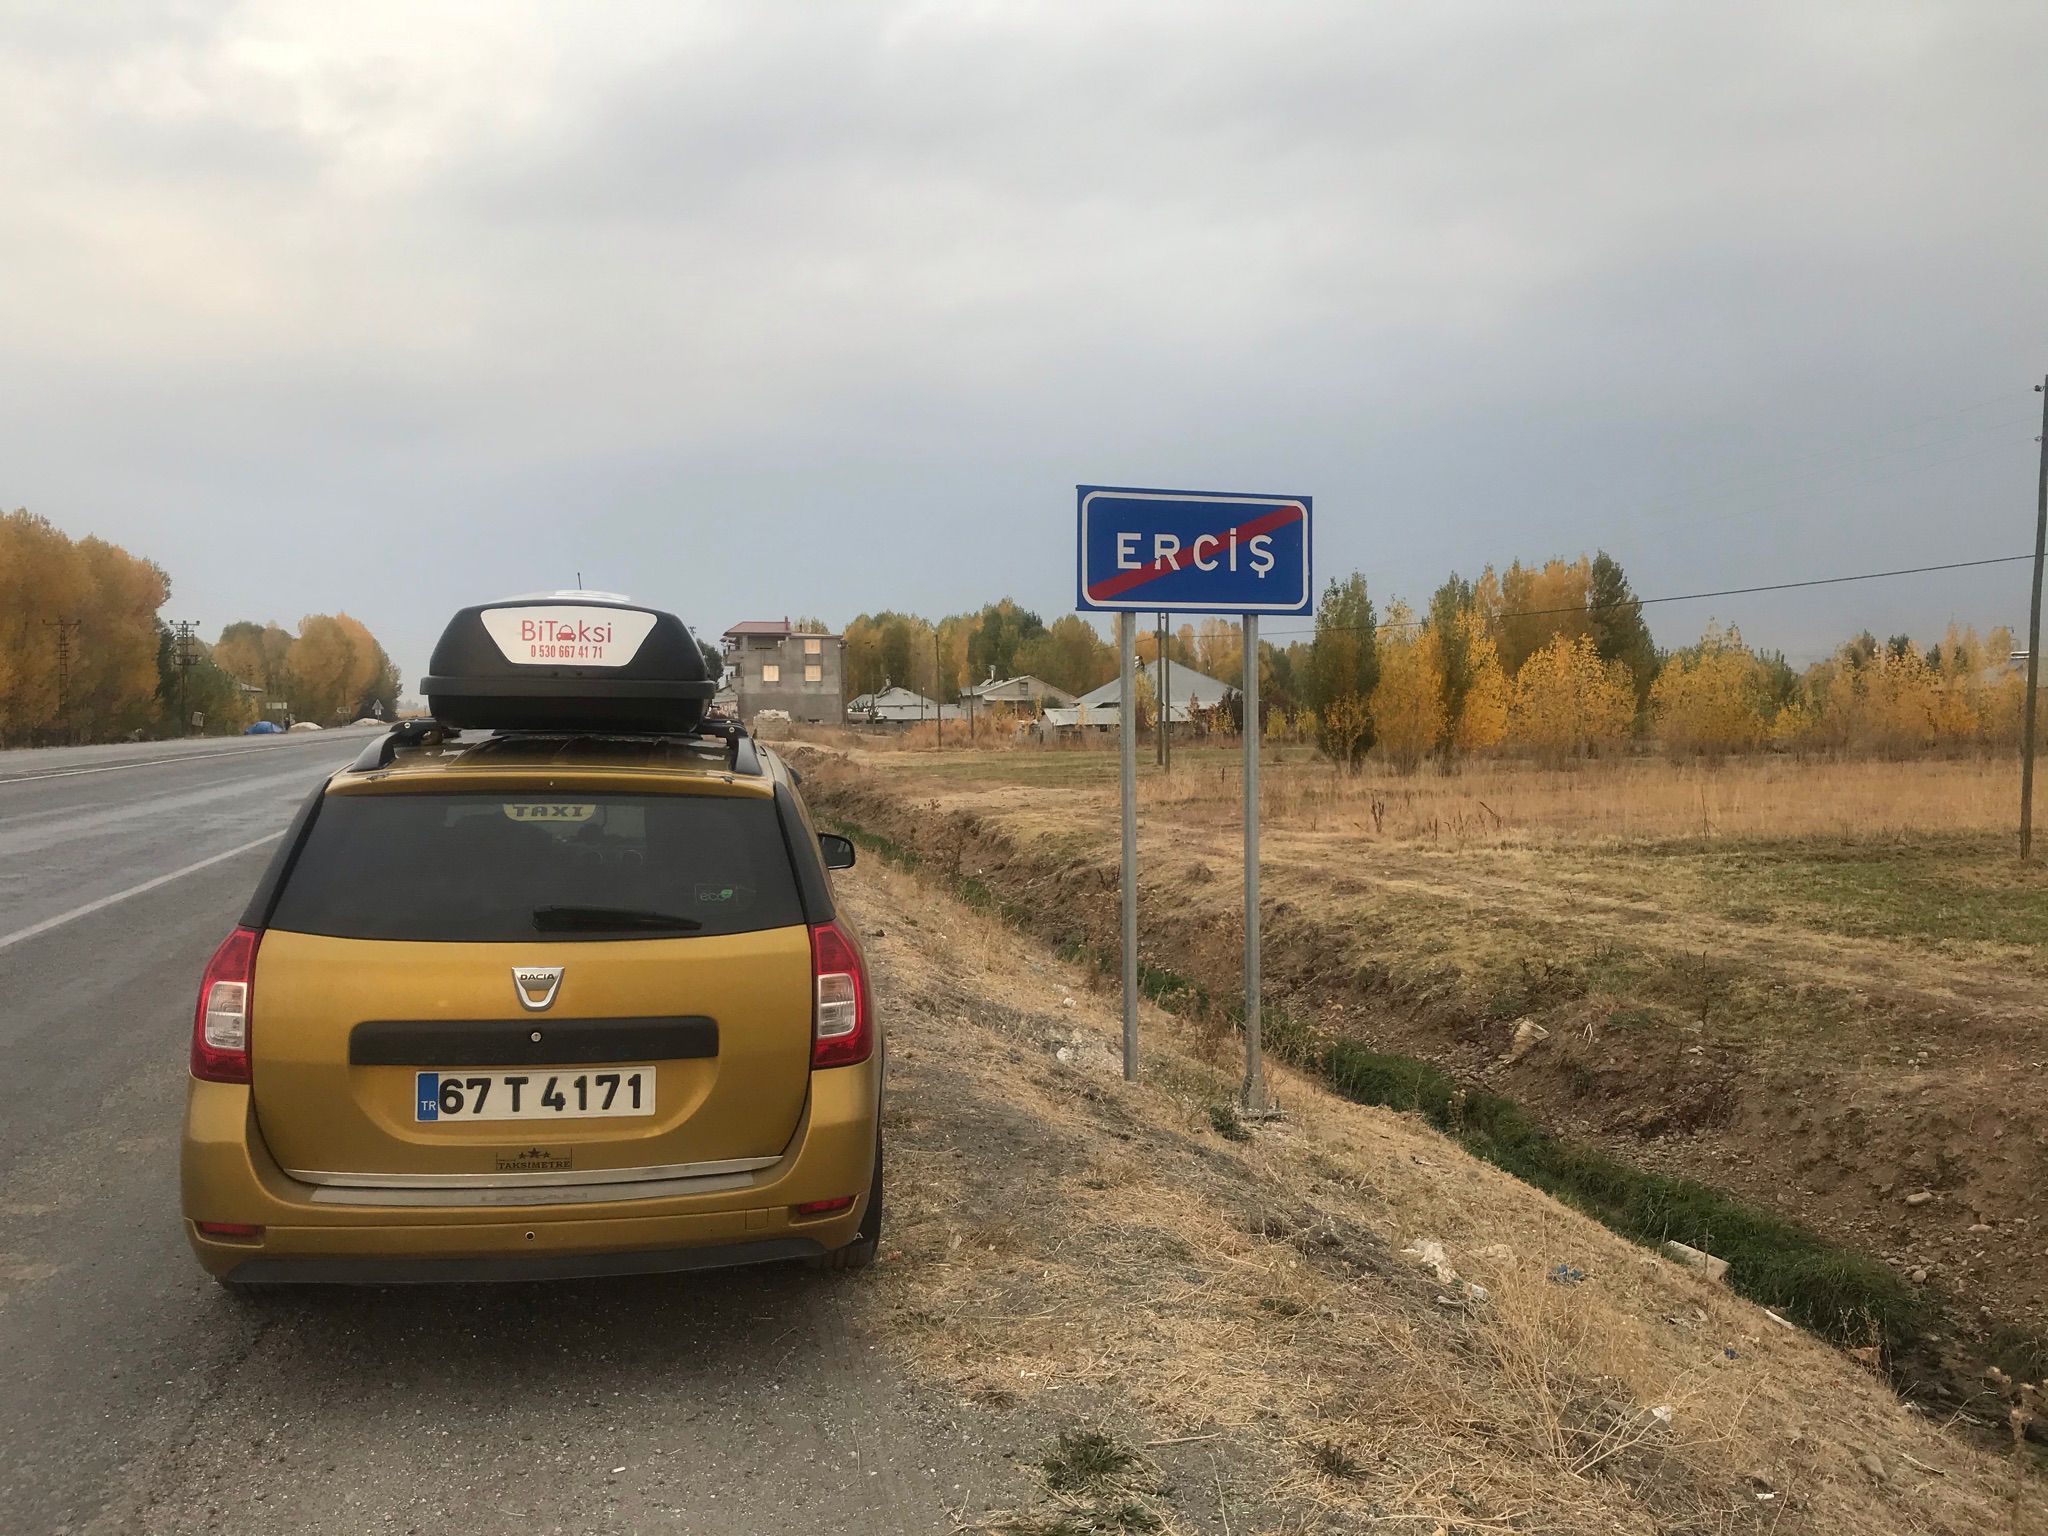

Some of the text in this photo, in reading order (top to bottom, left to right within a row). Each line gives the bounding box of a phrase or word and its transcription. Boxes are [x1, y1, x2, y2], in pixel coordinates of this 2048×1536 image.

[1117, 527, 1275, 578] ERCİŞ
[531, 645, 603, 658] 0 530 667 41 71
[513, 806, 584, 817] TAXI
[520, 973, 555, 981] DACIA
[439, 1073, 641, 1115] 67 T 4171
[421, 1100, 437, 1111] TR
